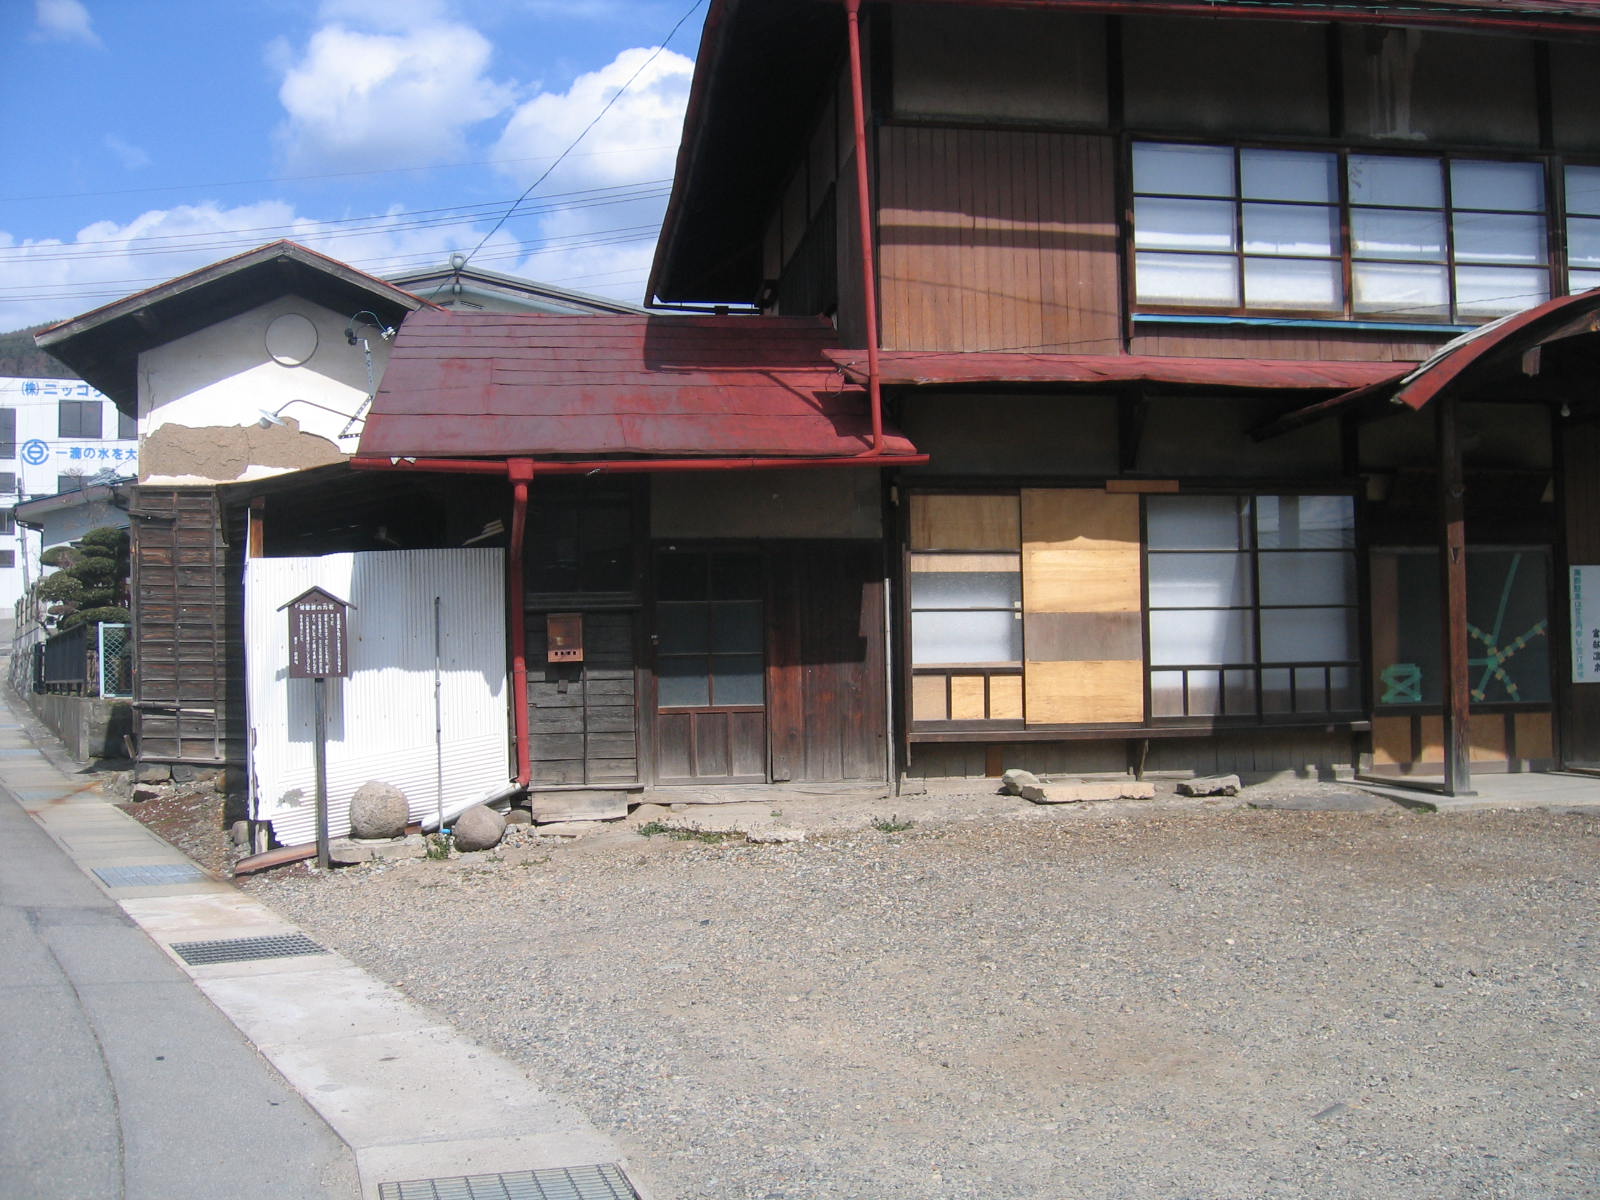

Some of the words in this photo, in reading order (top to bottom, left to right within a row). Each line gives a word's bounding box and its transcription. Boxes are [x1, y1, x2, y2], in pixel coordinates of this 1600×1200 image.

[55, 447, 137, 460] 一滴の水を大
